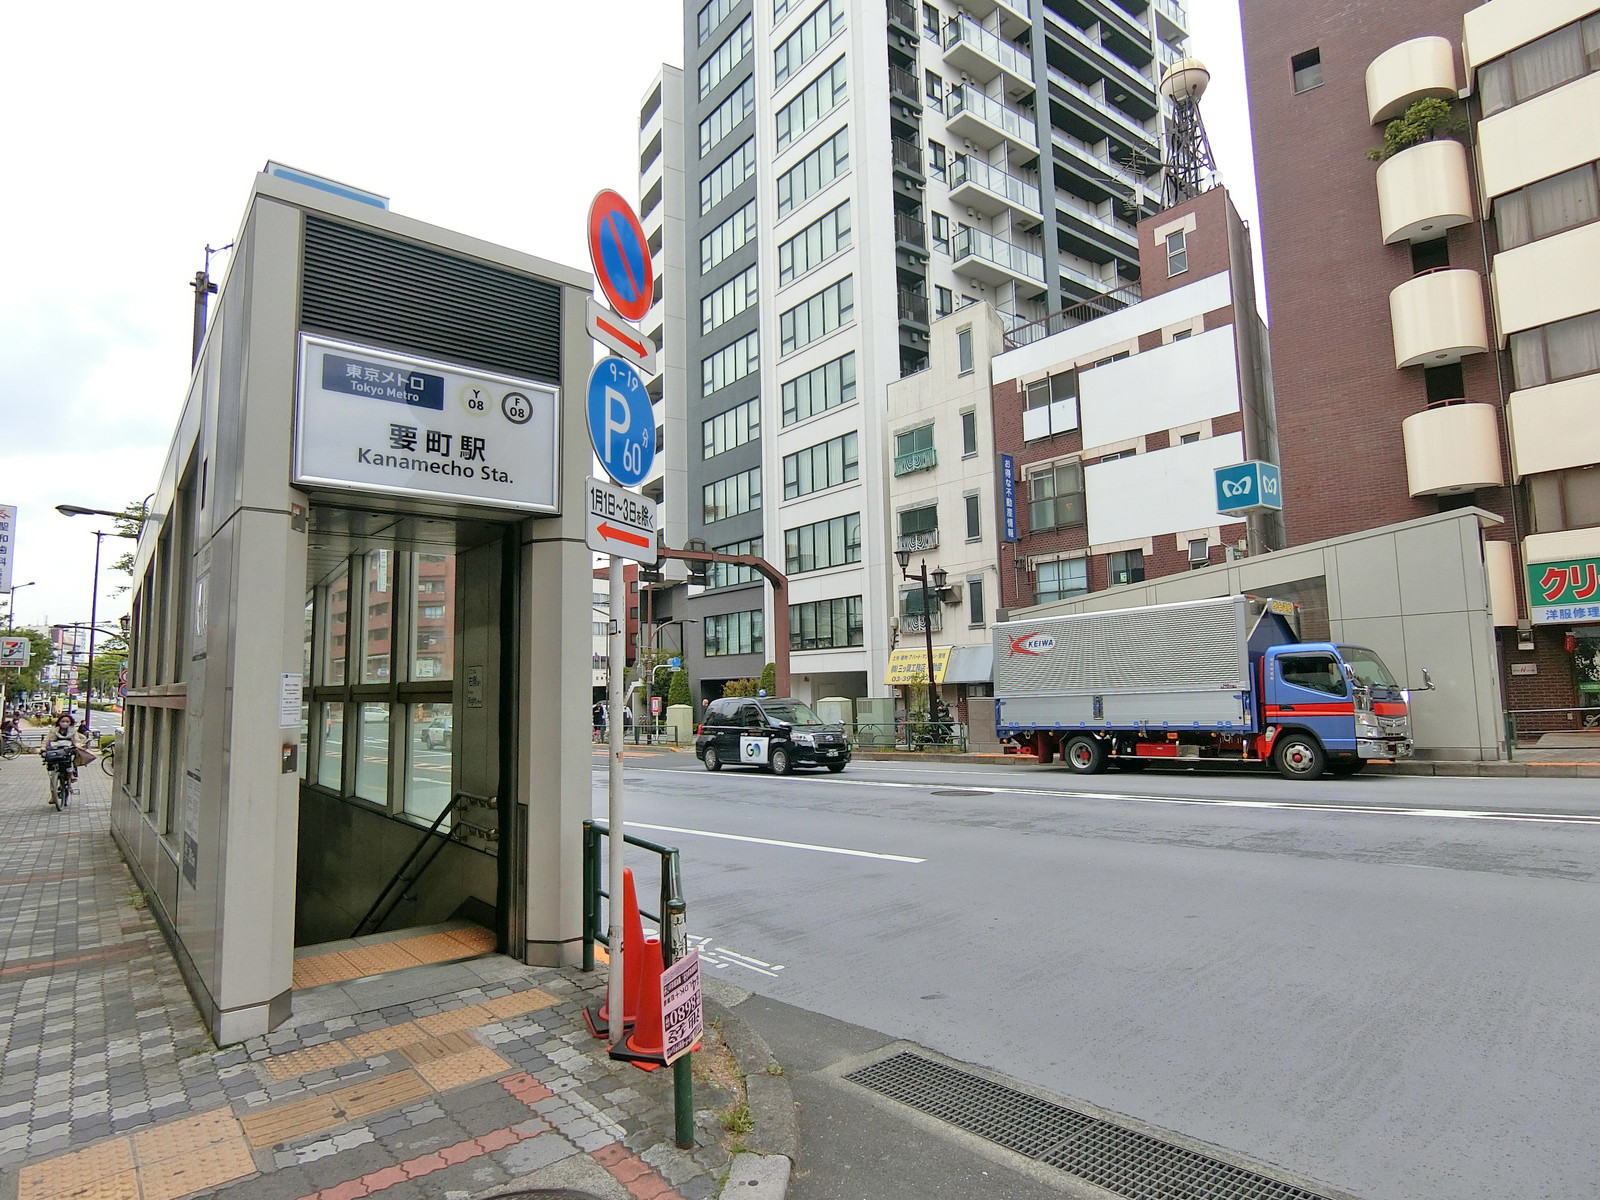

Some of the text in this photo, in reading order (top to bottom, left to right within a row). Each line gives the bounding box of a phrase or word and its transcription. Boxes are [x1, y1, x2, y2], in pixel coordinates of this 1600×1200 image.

[346, 362, 425, 391] 東京メトロ
[610, 363, 638, 392] 9-19
[351, 381, 420, 402] Tokyo Metro
[472, 389, 481, 399] Y
[515, 397, 521, 407] F
[468, 399, 484, 411] 08
[510, 407, 525, 418] 08
[605, 385, 631, 463] P
[389, 423, 486, 462] 要町駅
[358, 447, 514, 484] Kanamecho Sta.
[1004, 459, 1014, 538] お得な不動産情報
[1539, 563, 1600, 602] クリ
[1546, 606, 1599, 620] 洋服修理
[1028, 639, 1053, 648] KEIWA
